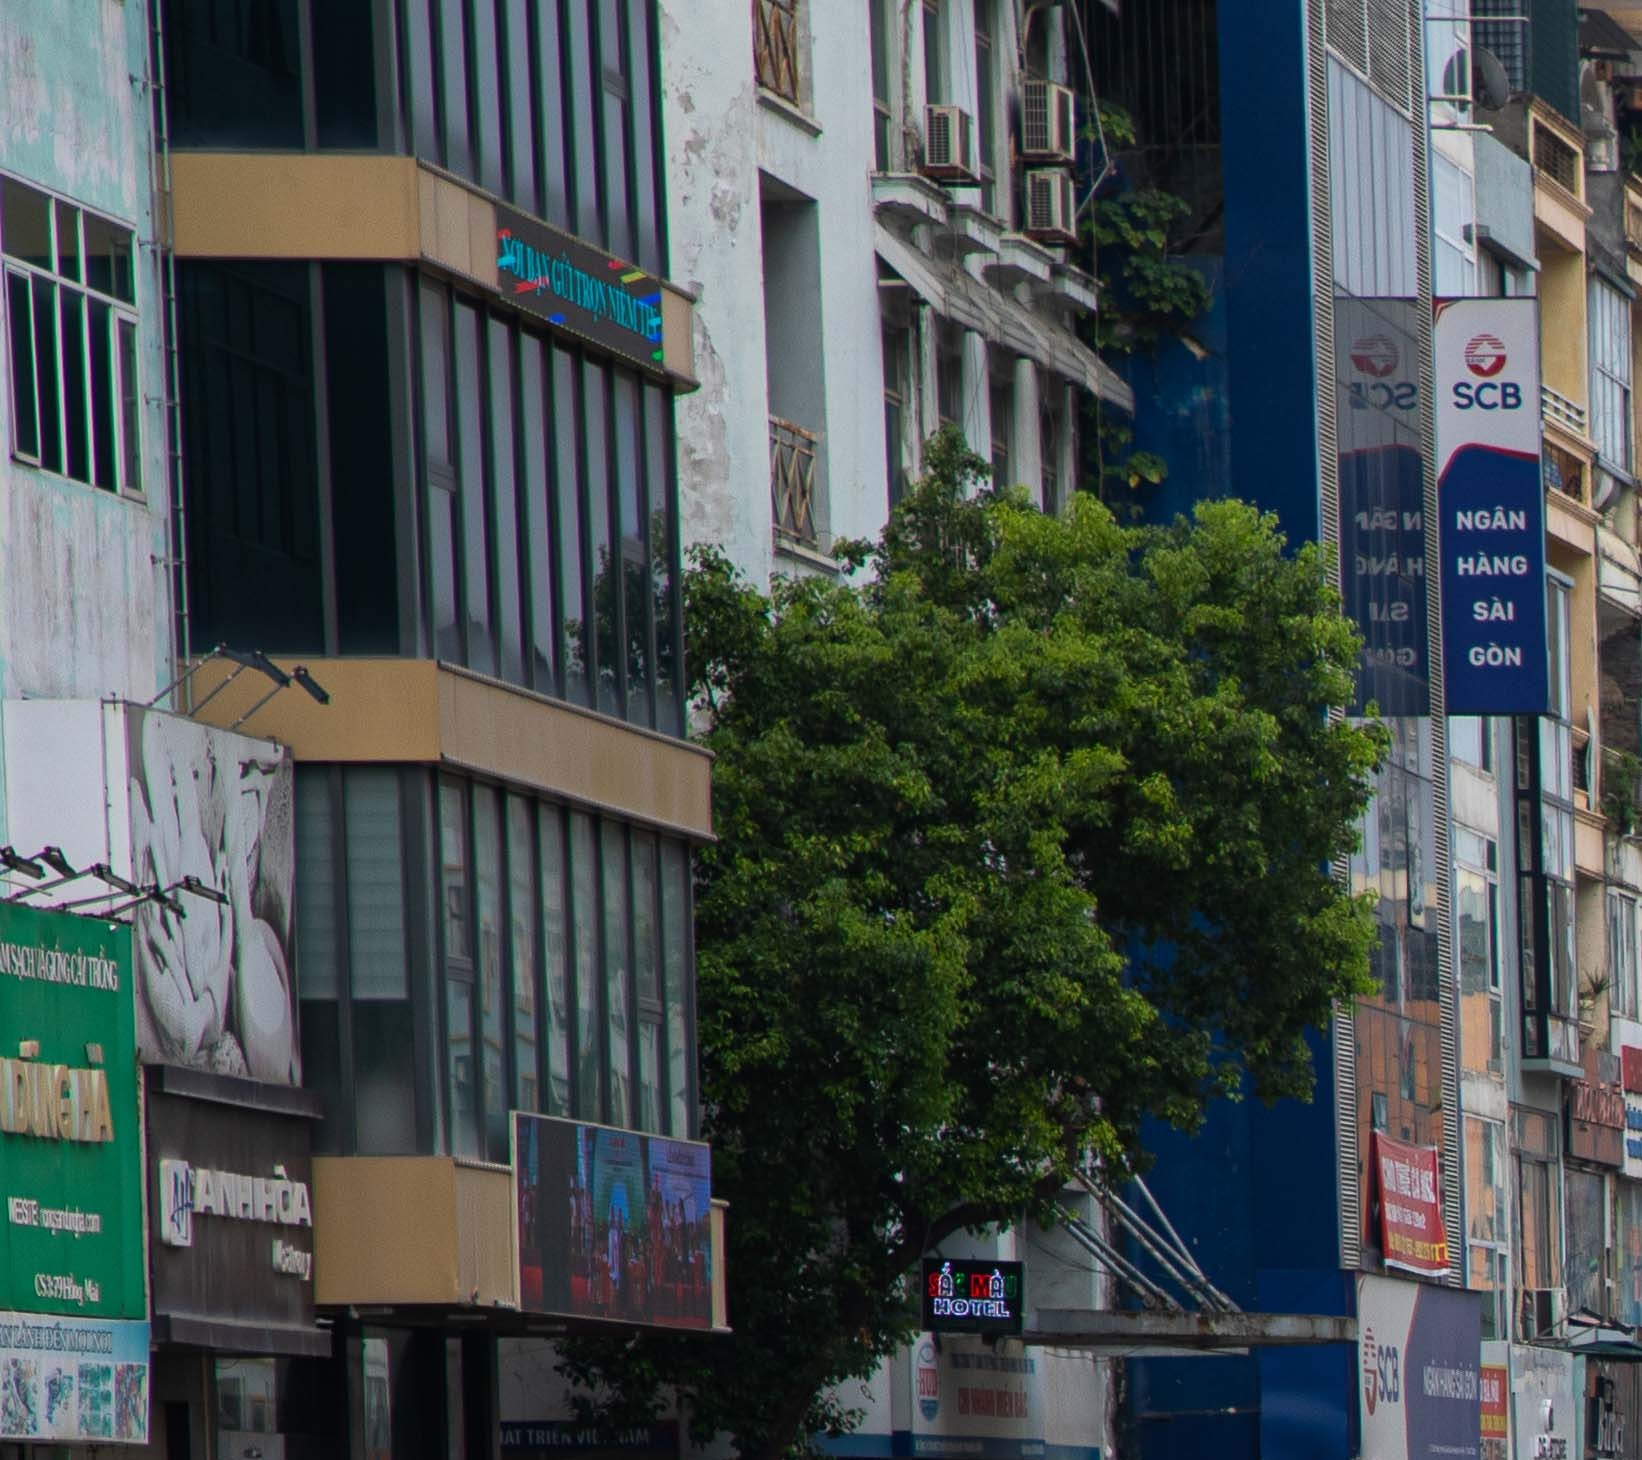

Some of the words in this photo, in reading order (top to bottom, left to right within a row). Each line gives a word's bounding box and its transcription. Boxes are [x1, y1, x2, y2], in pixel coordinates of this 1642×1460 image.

[1453, 382, 1522, 410] SCB
[1456, 506, 1526, 531] NGÂN
[1458, 552, 1528, 576] HÀNG
[1472, 597, 1514, 622] SÀI
[1468, 643, 1522, 667] GÒN
[252, 1164, 313, 1227] HÒA
[933, 1298, 1010, 1318] HOTEL
[1377, 1345, 1400, 1403] SCB
